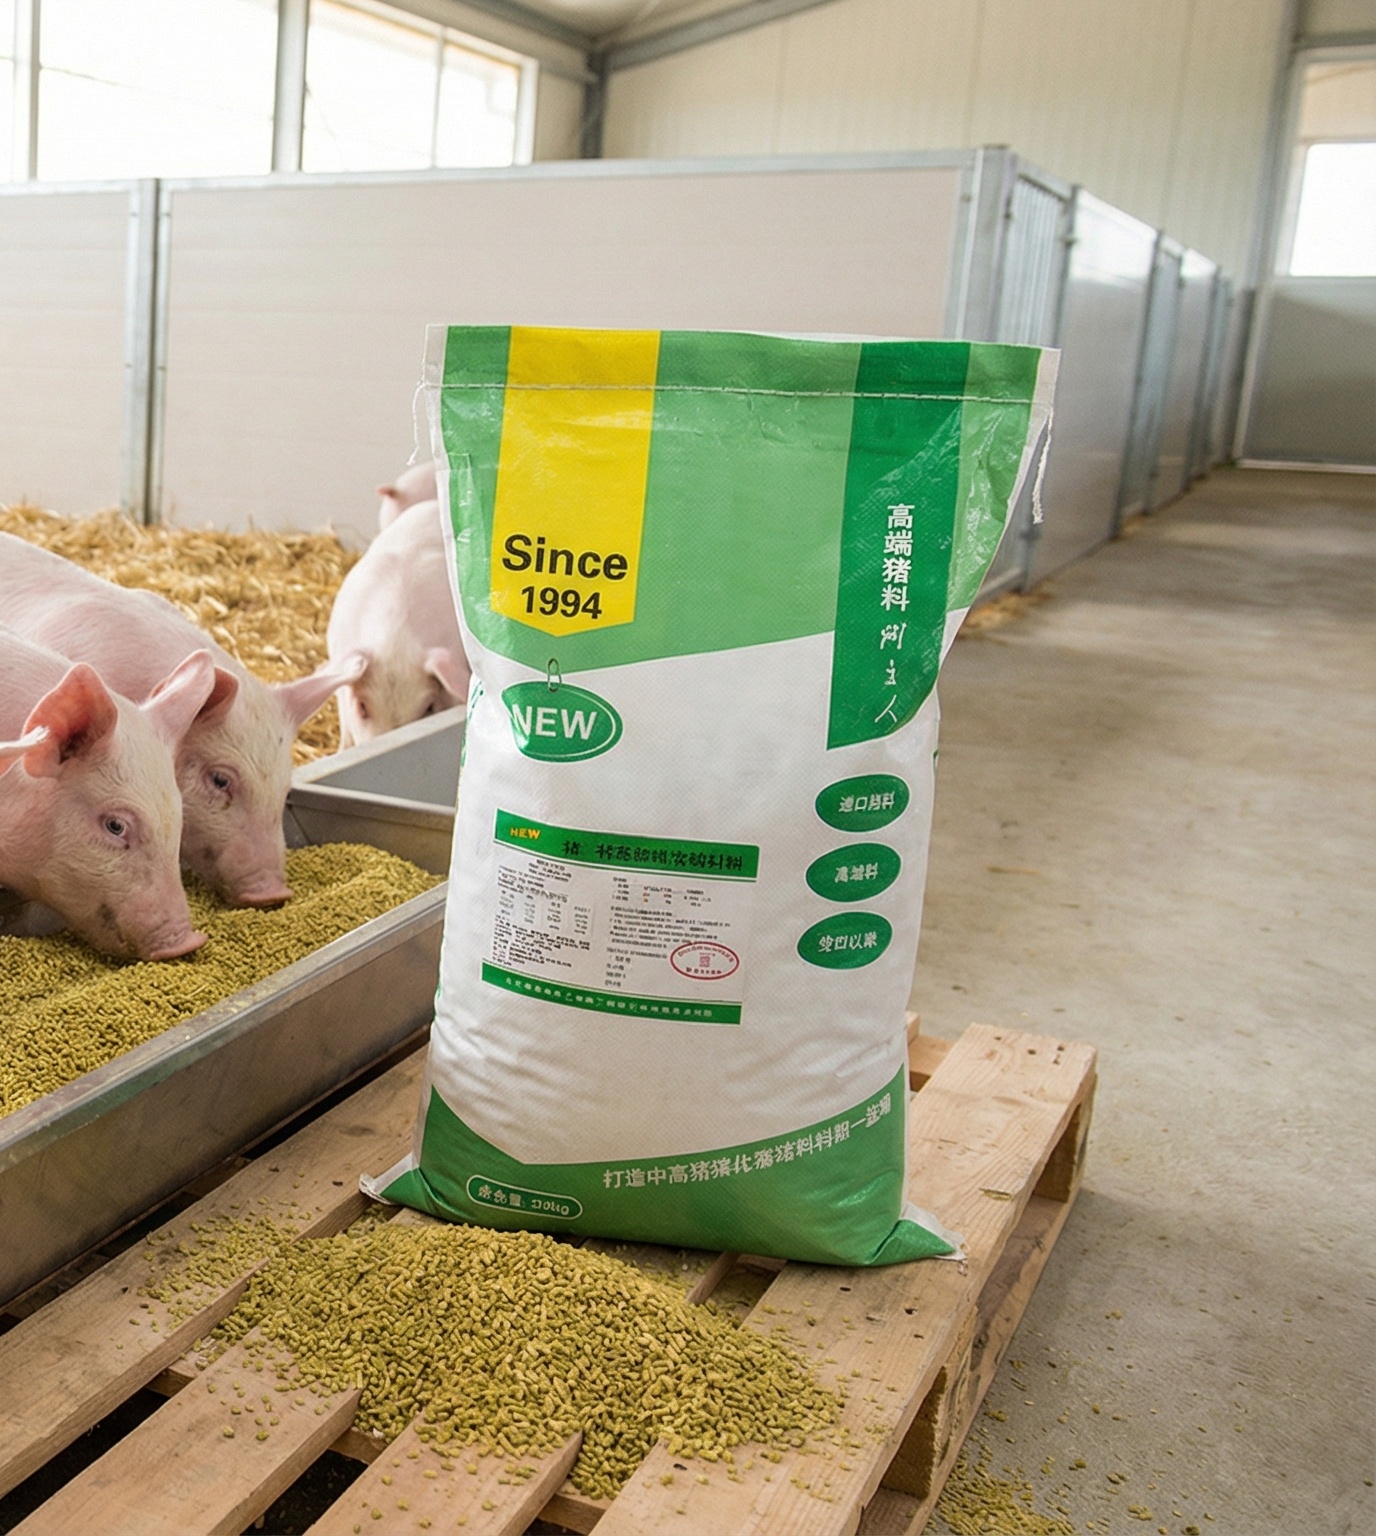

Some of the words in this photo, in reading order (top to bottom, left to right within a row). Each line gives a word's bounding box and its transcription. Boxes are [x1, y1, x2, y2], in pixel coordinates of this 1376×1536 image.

[502, 534, 629, 581] Since
[521, 586, 602, 620] 1994
[511, 703, 598, 741] NEW
